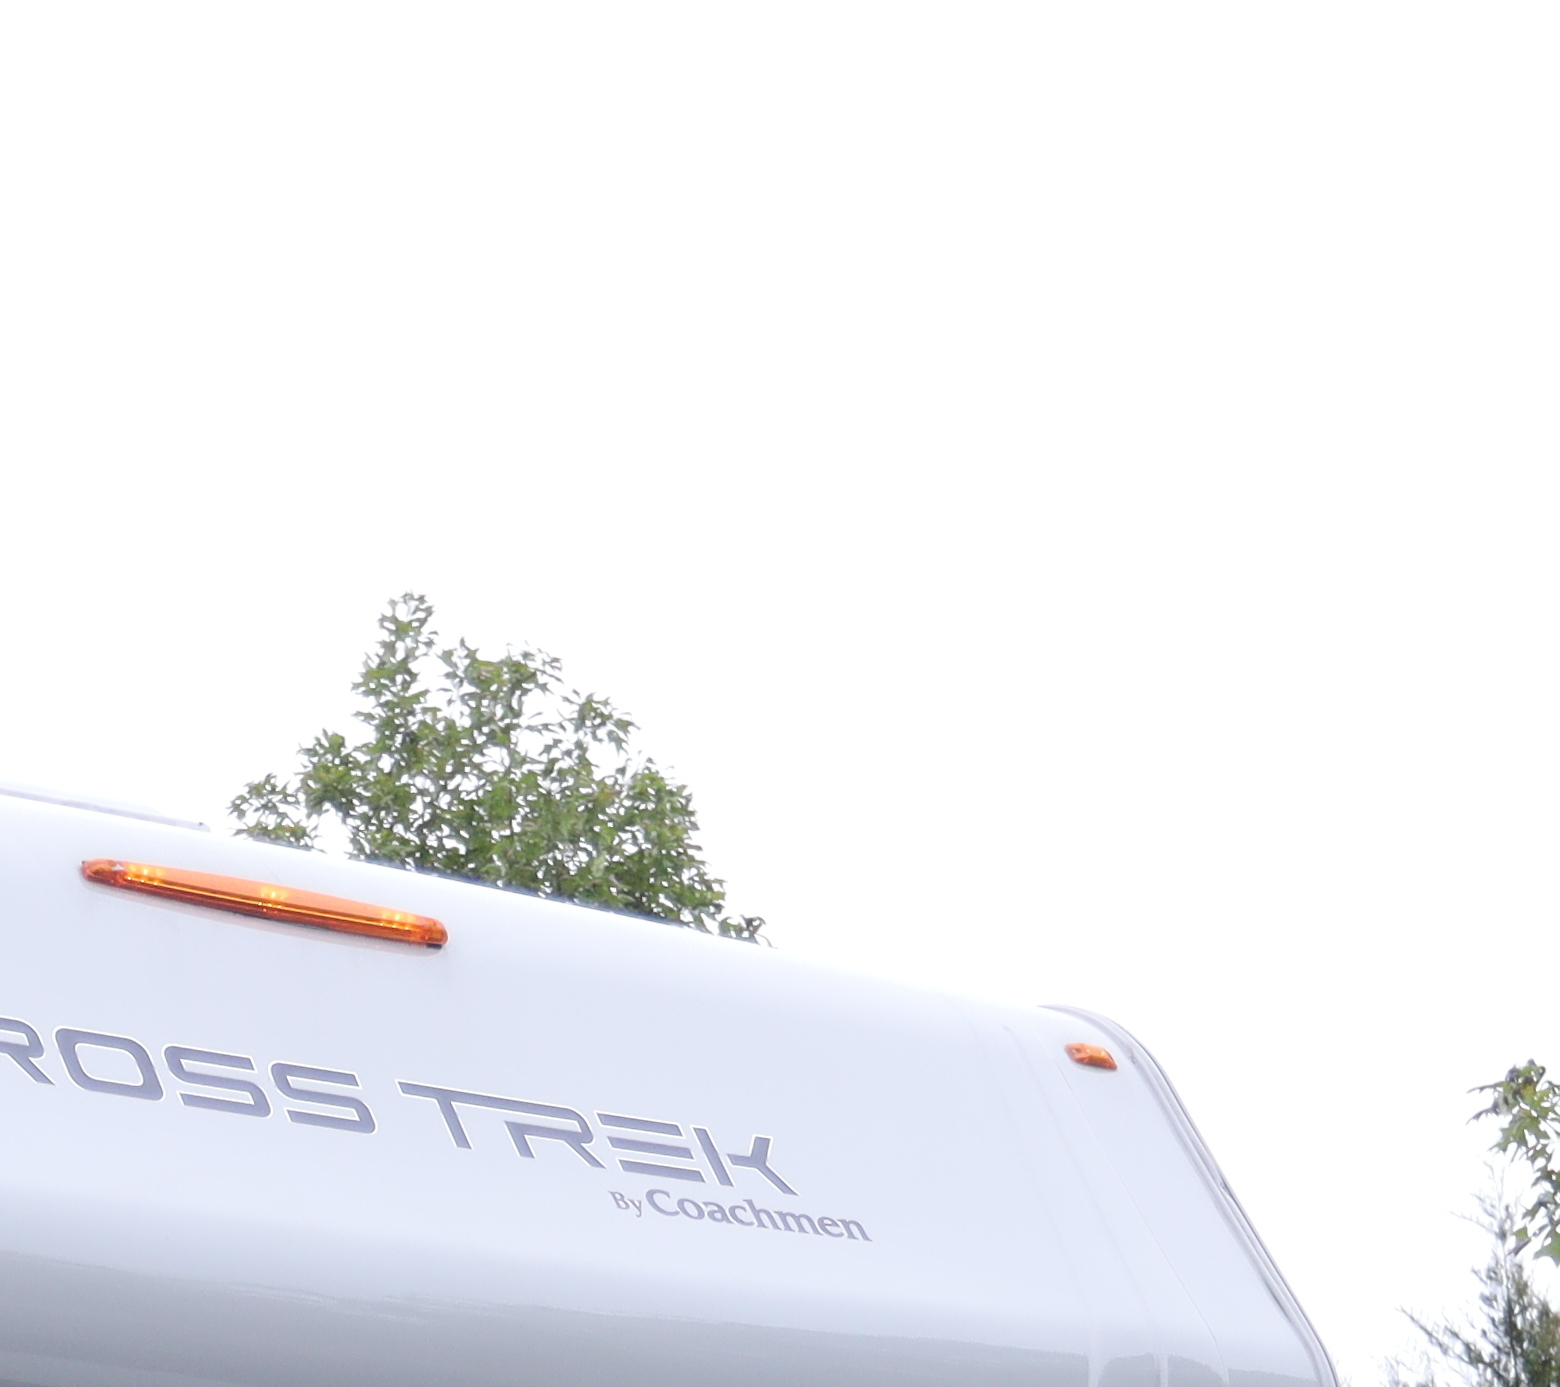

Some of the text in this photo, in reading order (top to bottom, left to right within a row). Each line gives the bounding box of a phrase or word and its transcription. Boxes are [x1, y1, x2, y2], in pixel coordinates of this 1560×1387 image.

[397, 1079, 799, 1197] TREK
[608, 1188, 873, 1242] By Coachmen
